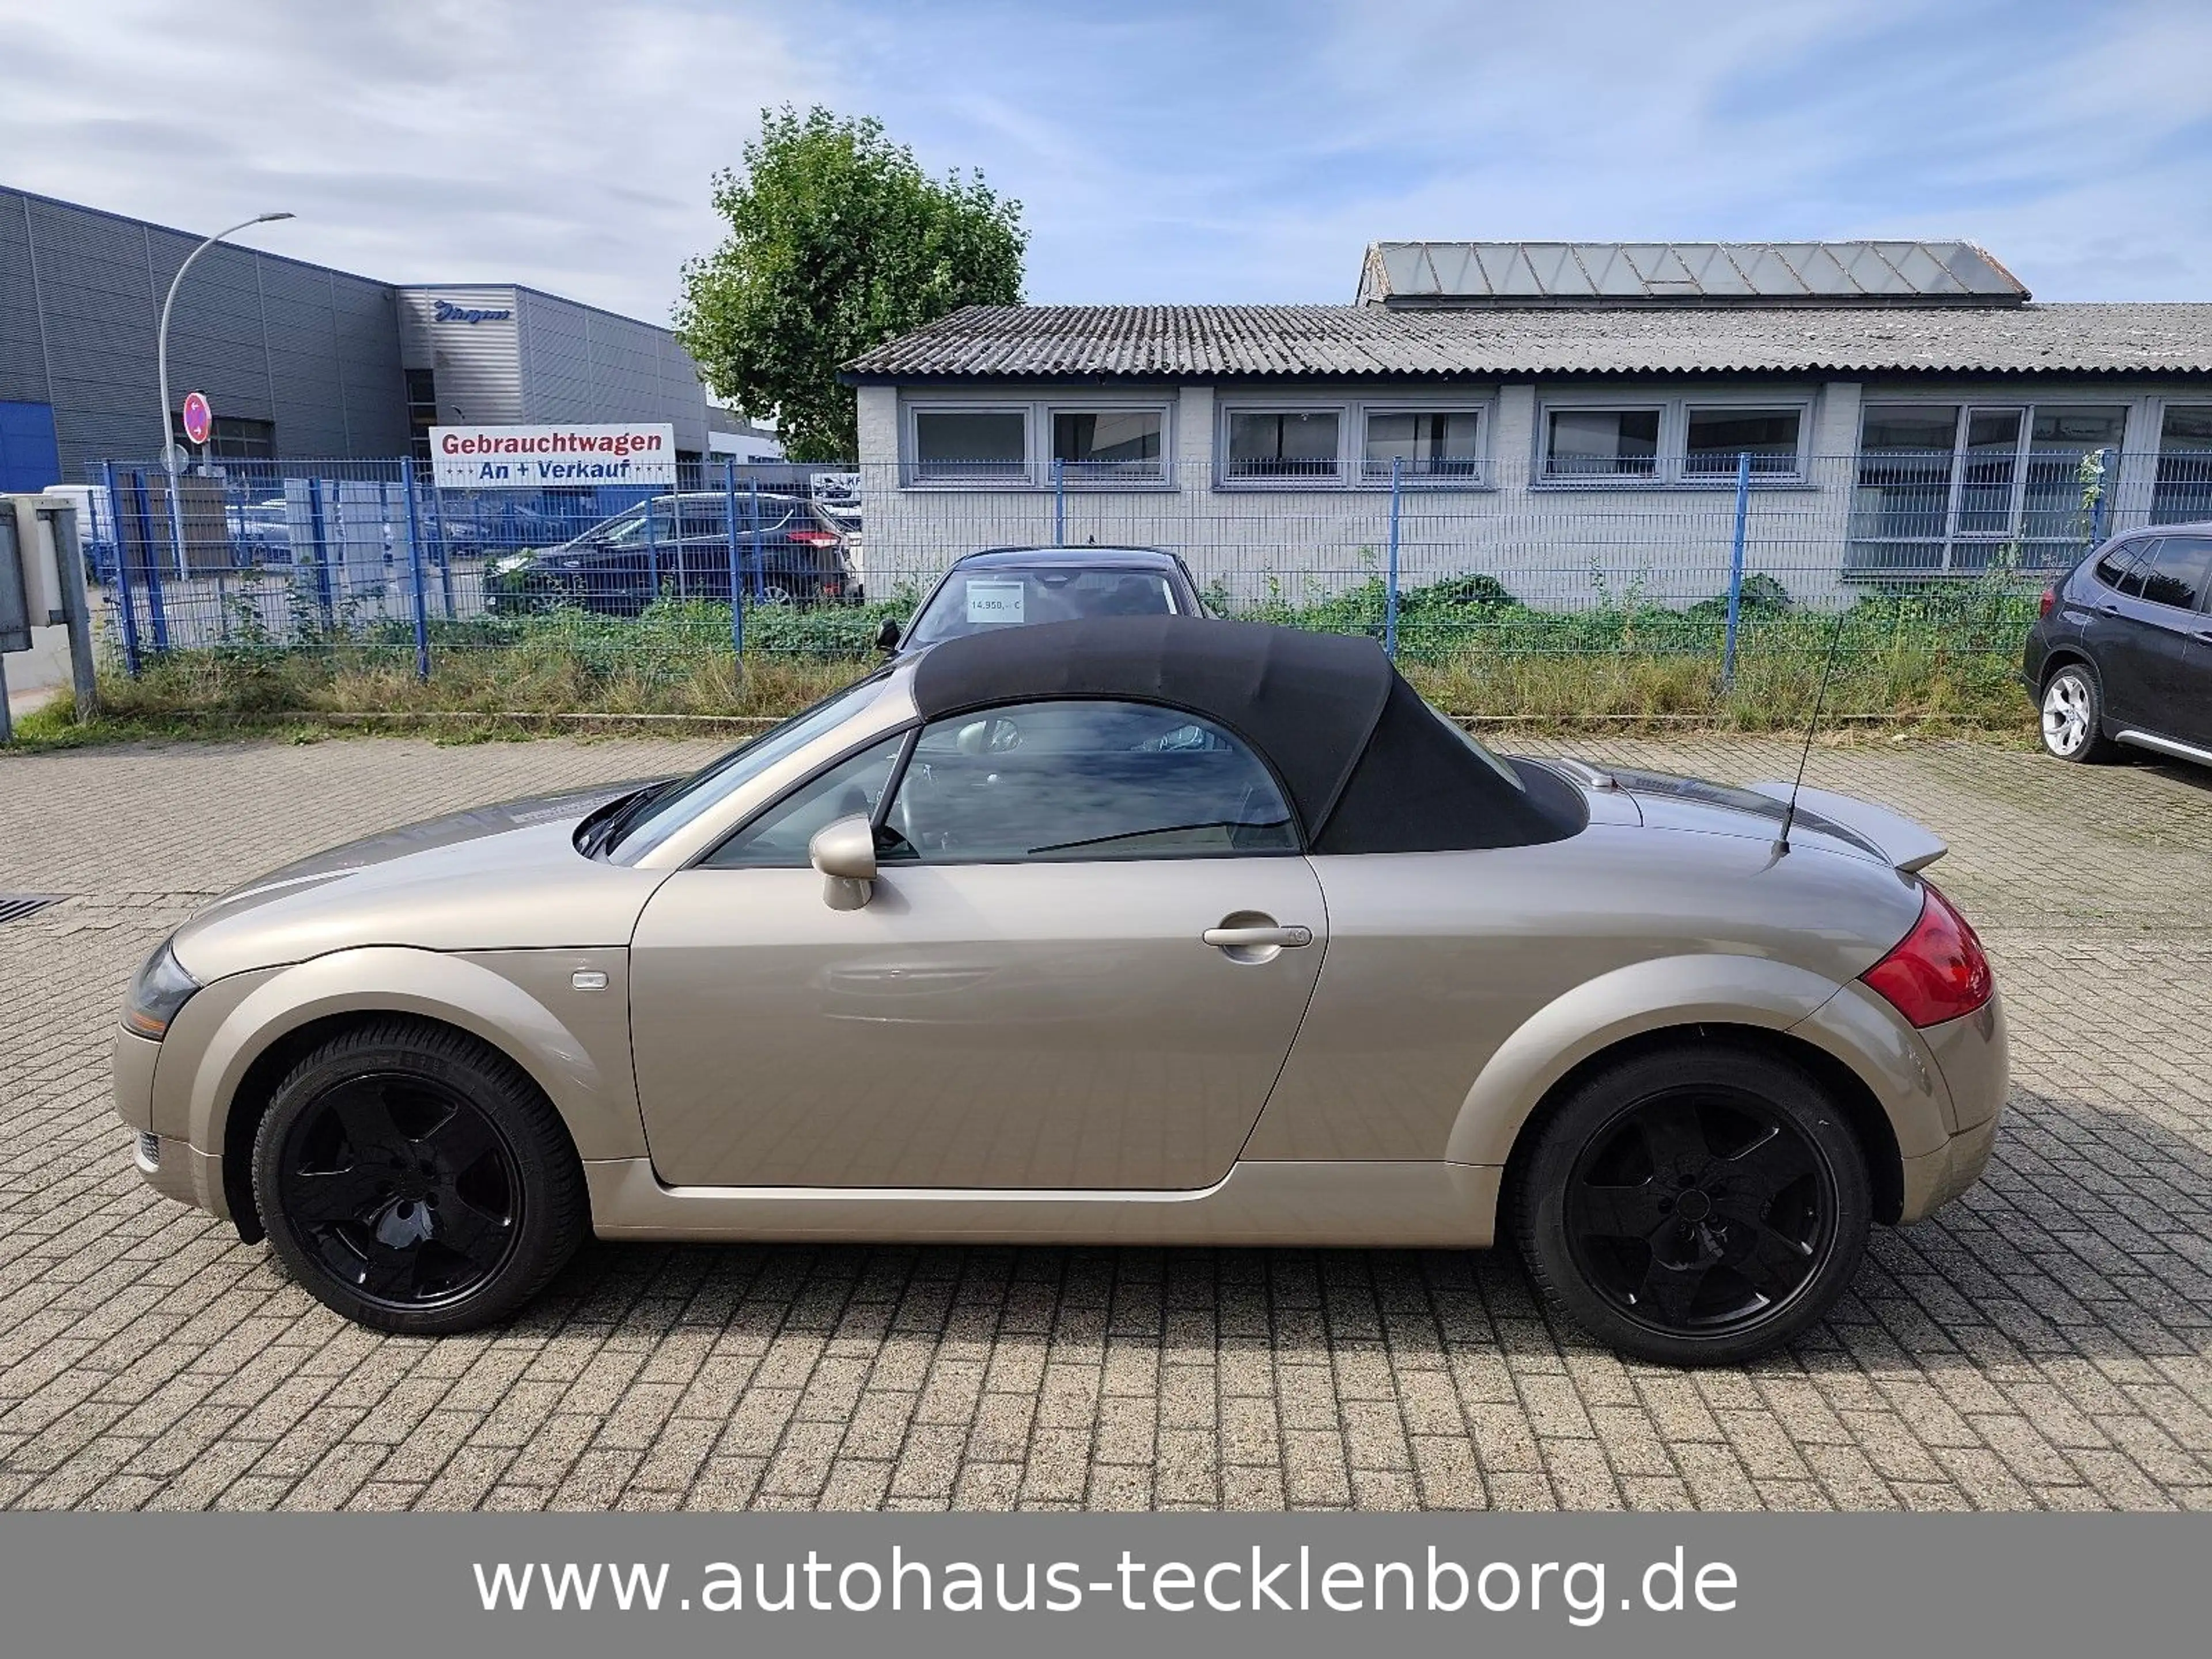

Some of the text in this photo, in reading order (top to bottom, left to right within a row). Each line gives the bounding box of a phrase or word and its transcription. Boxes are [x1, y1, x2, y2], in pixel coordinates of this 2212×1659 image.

[442, 433, 662, 456] Gebrauchtwagen
[479, 460, 630, 479] An + Verkauf
